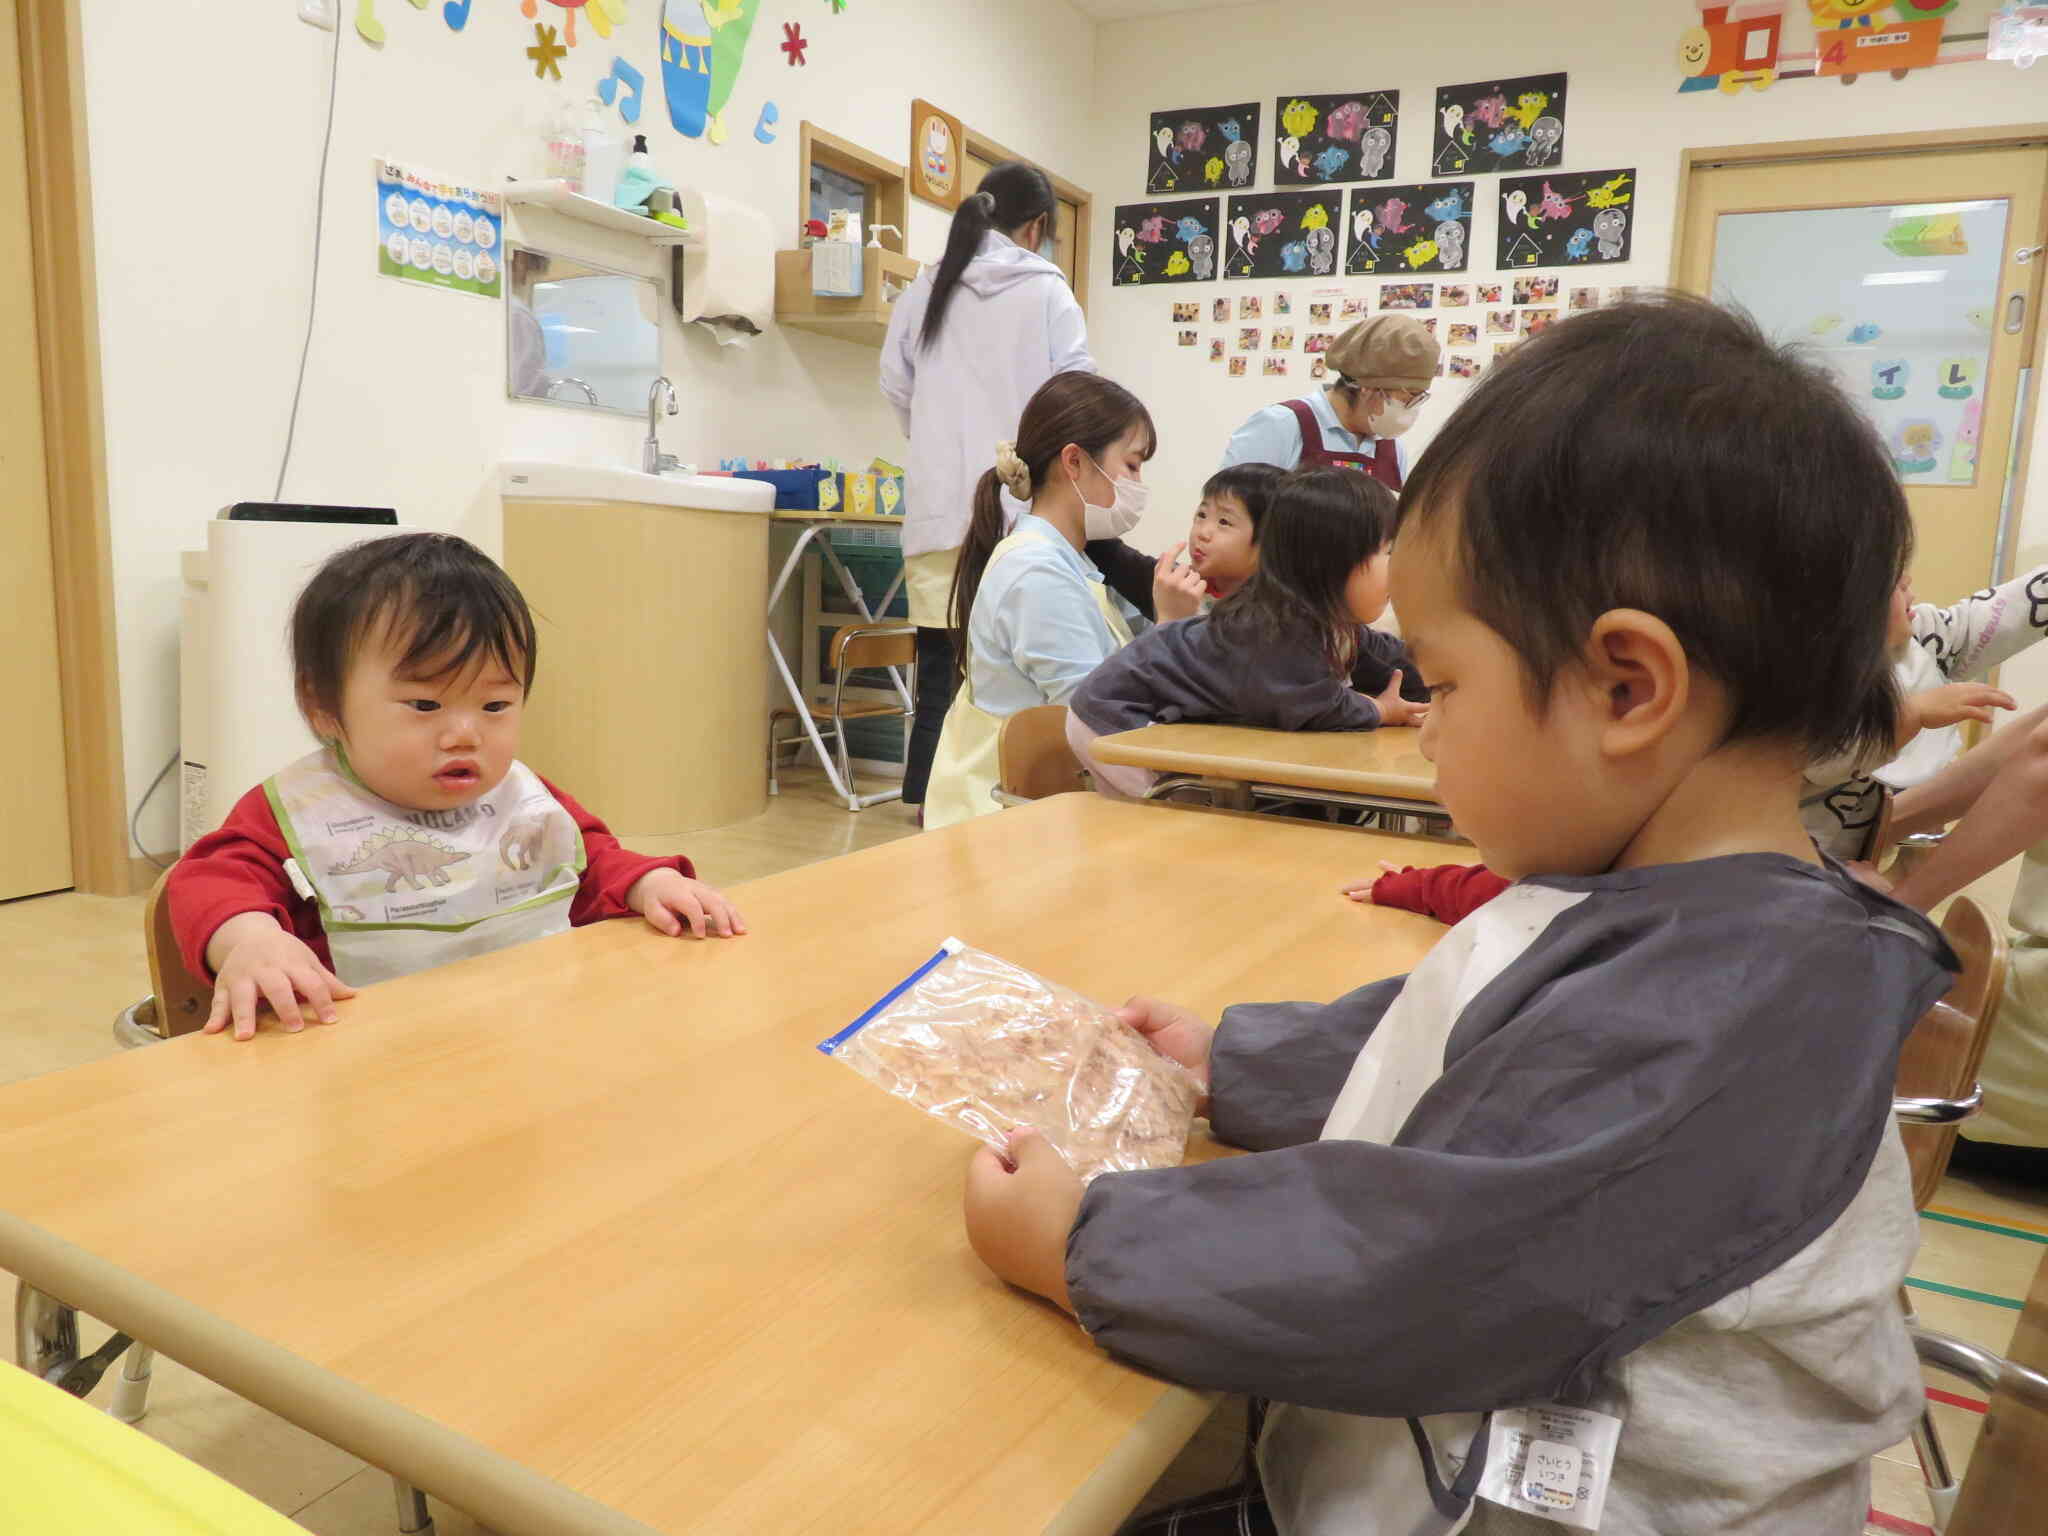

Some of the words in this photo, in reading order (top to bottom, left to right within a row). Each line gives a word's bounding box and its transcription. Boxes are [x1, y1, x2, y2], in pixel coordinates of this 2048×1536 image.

[1822, 40, 1847, 65] 4
[1537, 1454, 1572, 1470] さいとう
